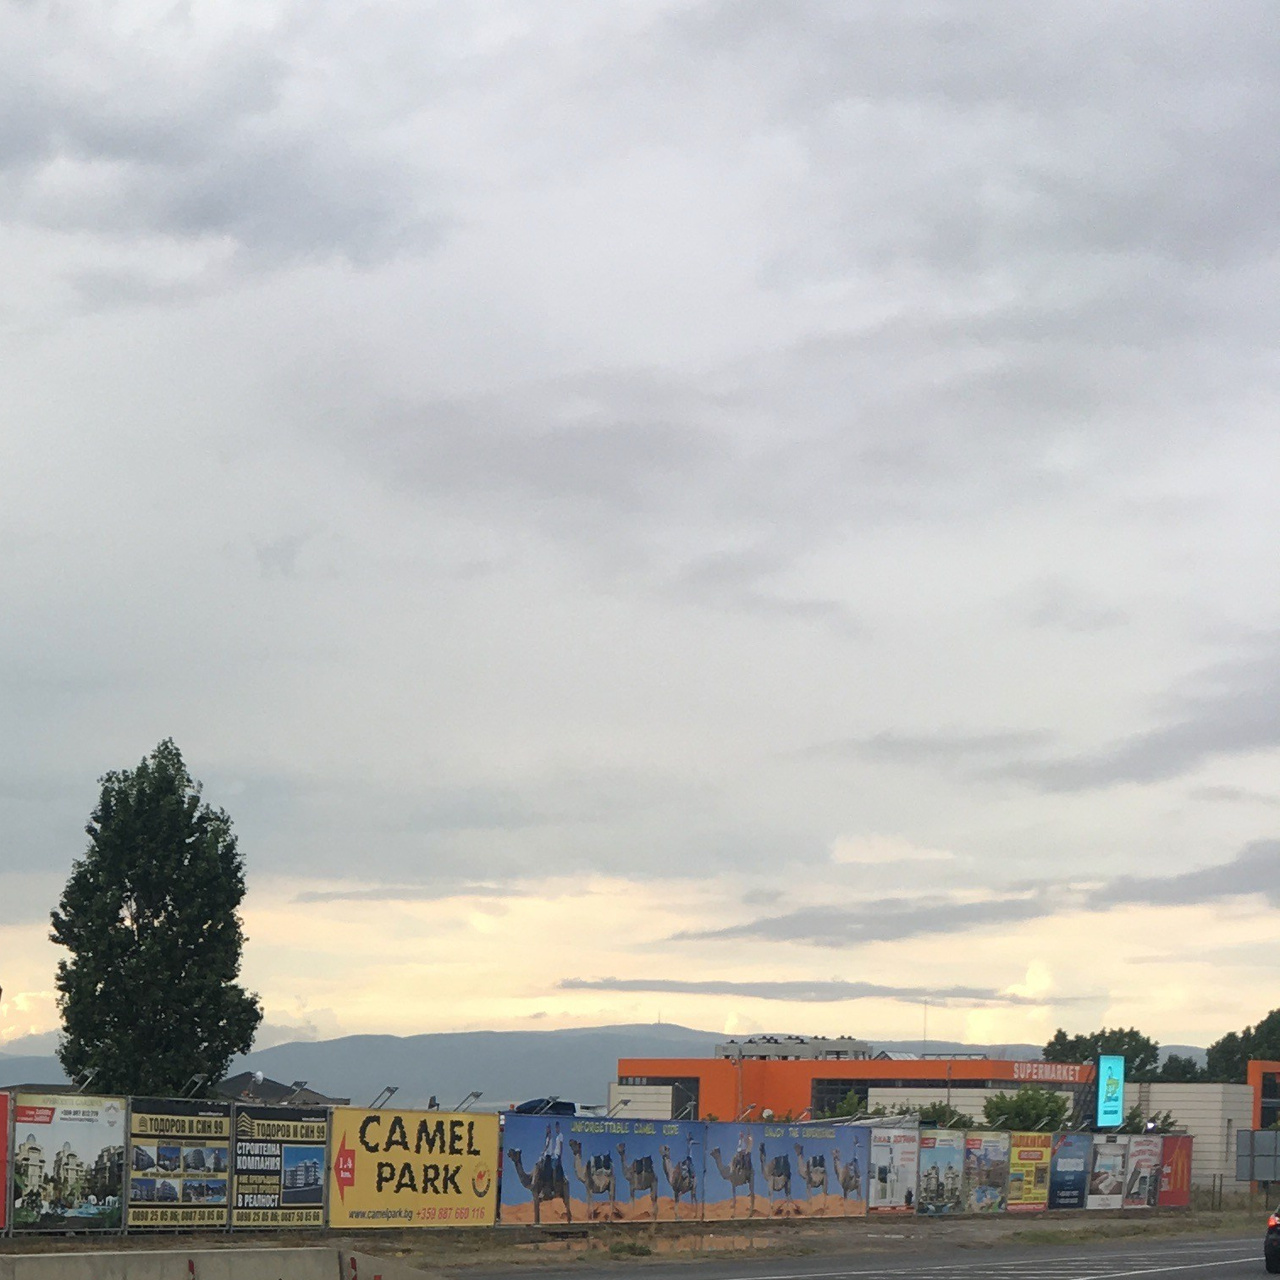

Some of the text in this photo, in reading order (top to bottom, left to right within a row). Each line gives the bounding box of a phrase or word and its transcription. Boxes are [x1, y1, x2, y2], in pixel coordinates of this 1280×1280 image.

[1013, 1062, 1081, 1081] SUPERMARKET
[149, 1118, 224, 1134] ТОДОРОВ И СИН 99
[256, 1122, 325, 1139] ТОДОРОВ И СИН 99
[571, 1121, 629, 1134] UNFORGETTABLE
[358, 1115, 480, 1156] CAMEL
[237, 1142, 280, 1155] СТРОИТЕЛНА
[237, 1156, 280, 1170] КОМПАНИЯ
[339, 1157, 353, 1169] 1.4
[376, 1161, 463, 1195] PARK
[238, 1194, 279, 1208] В РЕАЛНОСТ
[348, 1207, 413, 1221] www.camelpark.bg
[416, 1208, 436, 1220] +359
[472, 1206, 485, 1219] 116
